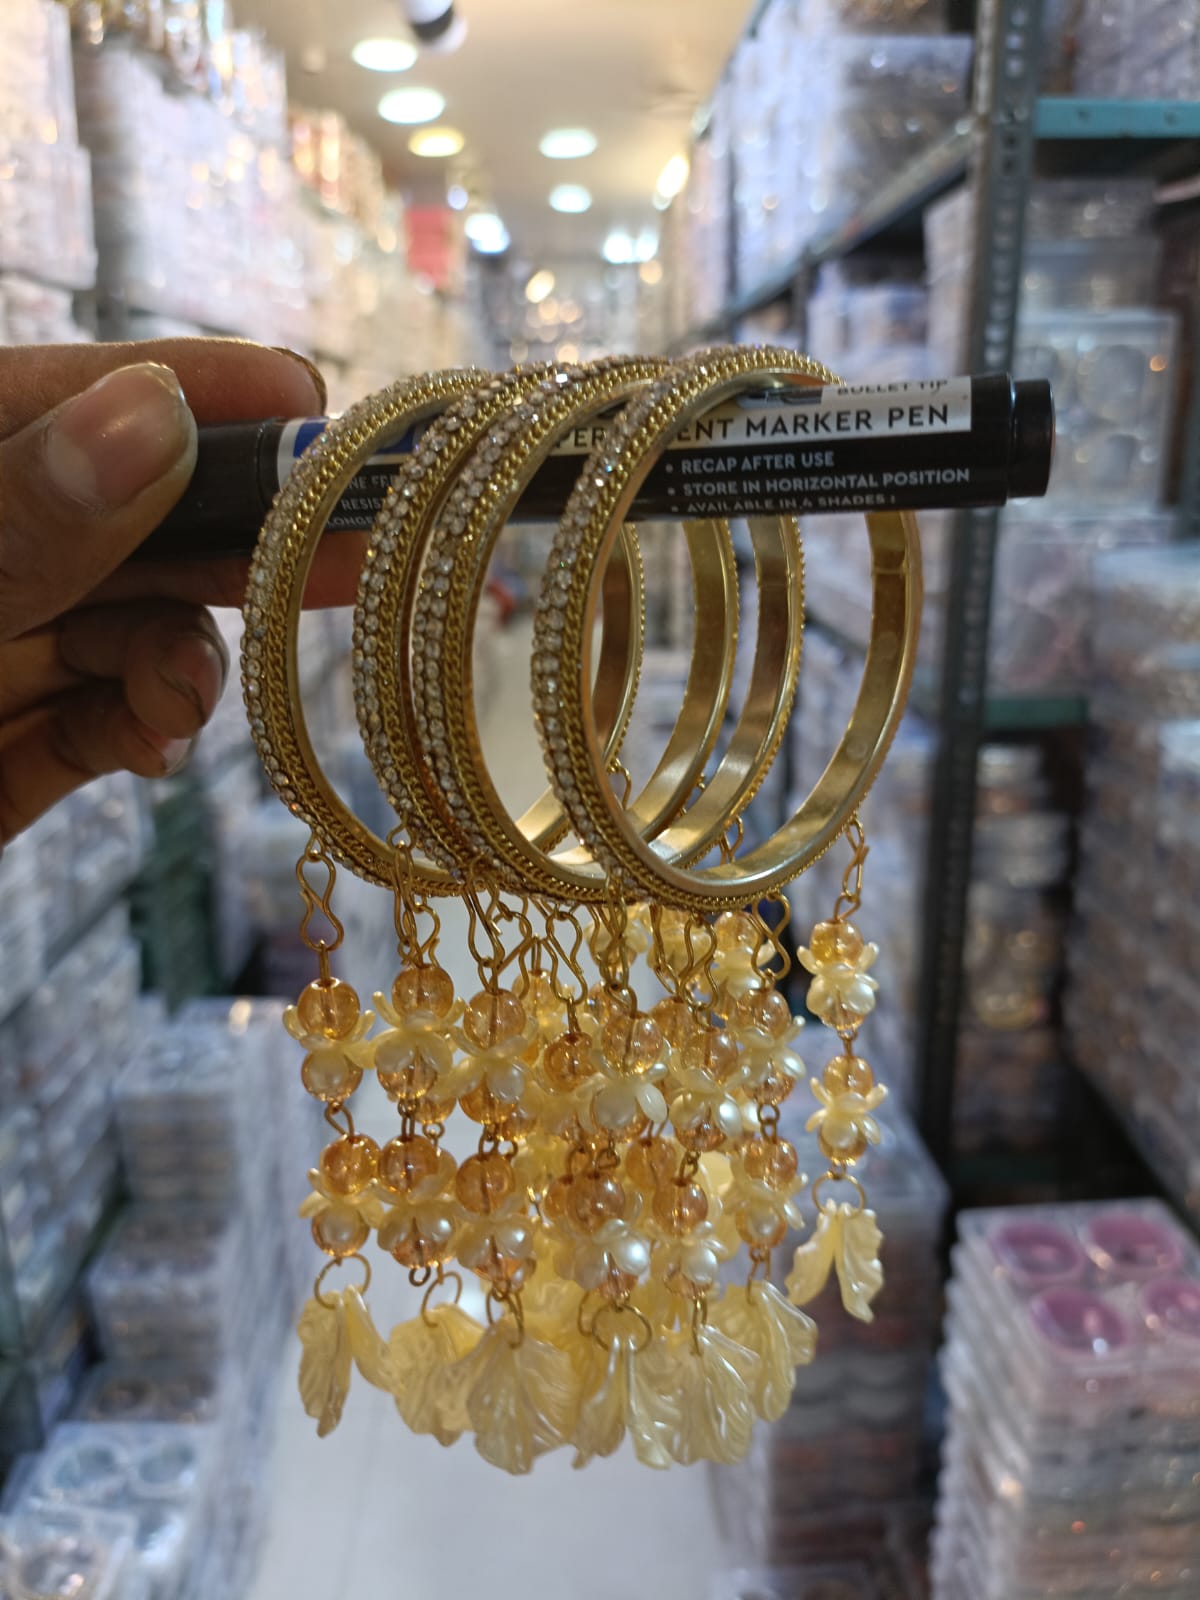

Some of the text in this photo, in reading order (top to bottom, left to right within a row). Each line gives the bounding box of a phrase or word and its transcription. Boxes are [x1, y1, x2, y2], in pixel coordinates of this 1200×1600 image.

[745, 409, 872, 438] MARKER
[888, 403, 948, 429] PEN
[681, 451, 835, 474] RECAP AFTER USE
[683, 467, 970, 496] STORE IN HORIZONTAL POSITION
[687, 498, 774, 513] AVAILABLE
[779, 497, 798, 509] IN
